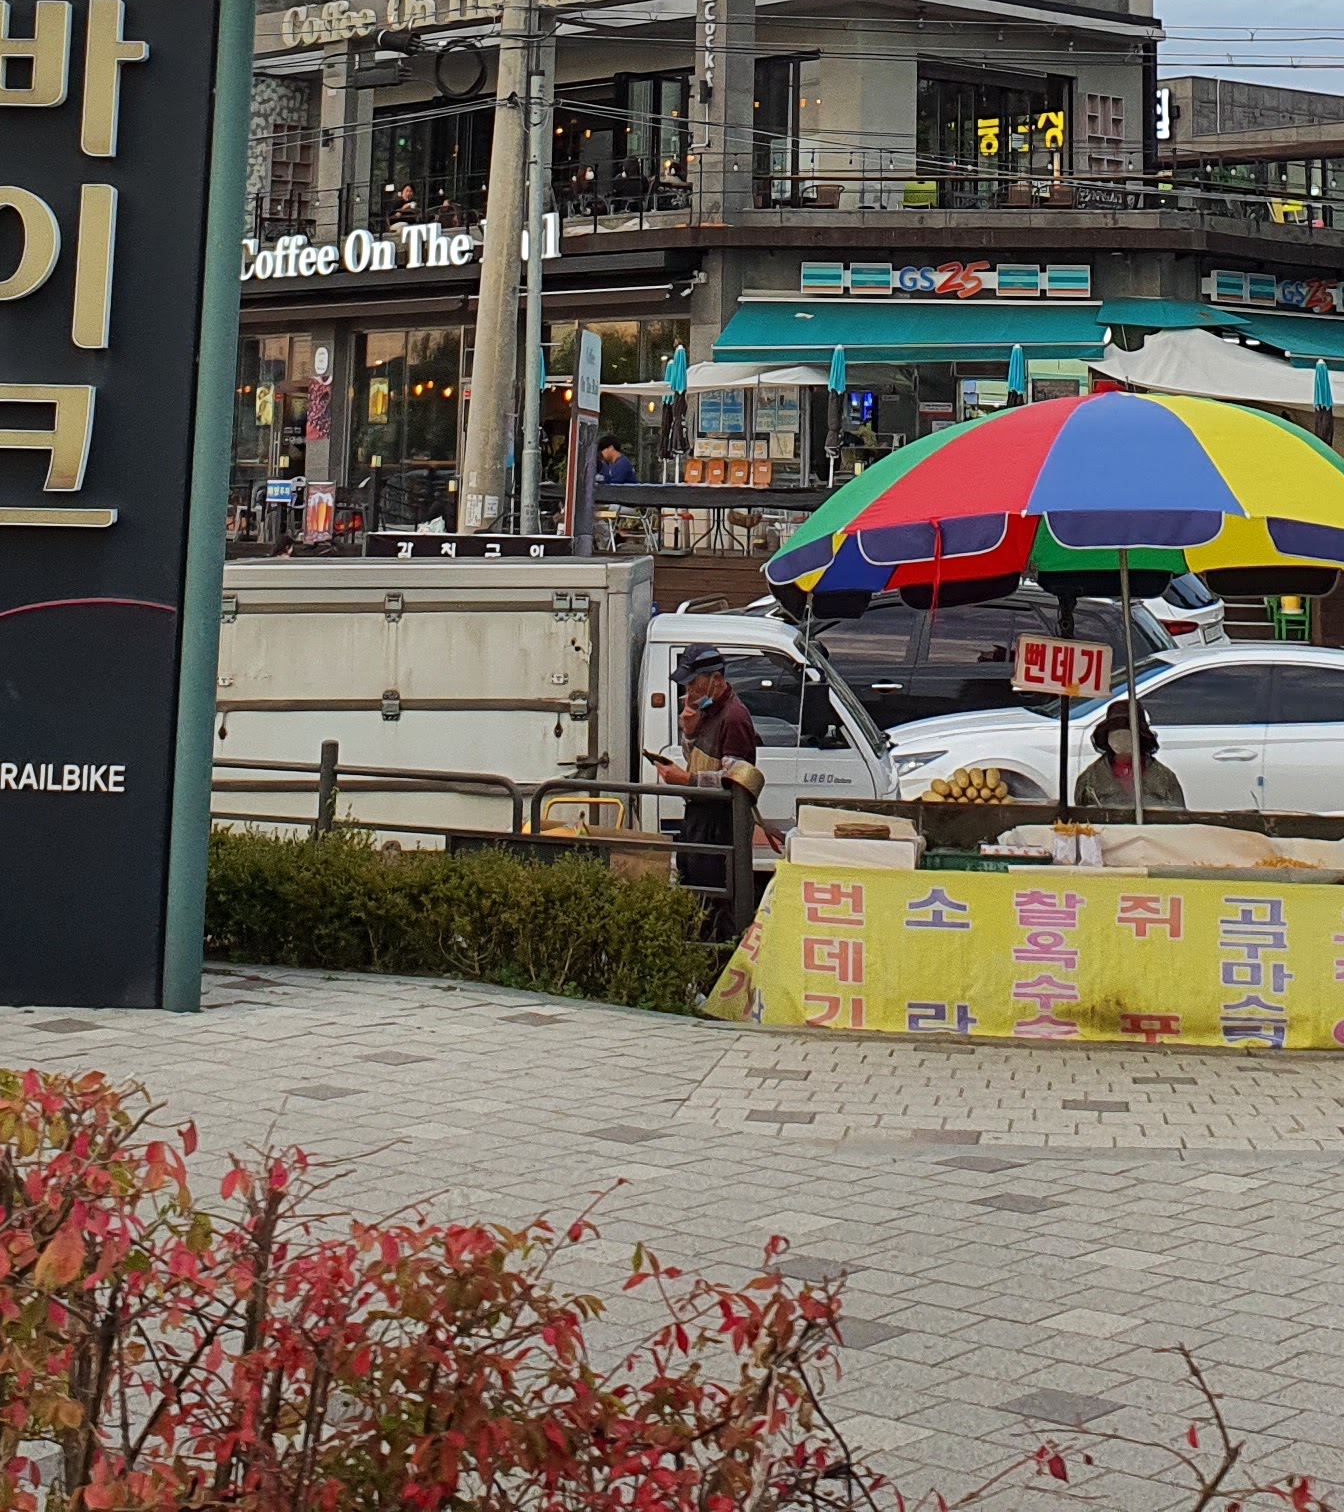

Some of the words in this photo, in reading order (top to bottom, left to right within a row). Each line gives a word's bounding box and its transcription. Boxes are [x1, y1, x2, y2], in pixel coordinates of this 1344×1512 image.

[282, 0, 377, 48] Coffee
[241, 233, 339, 282] Coffee
[344, 228, 398, 274] On
[402, 222, 475, 269] The
[898, 260, 991, 299] GS25
[1279, 277, 1338, 314] GS25
[1023, 642, 1104, 692] 뻔데기
[0, 762, 126, 793] RAILBIKE
[803, 773, 834, 784] LABO
[802, 881, 865, 1029] 번데기
